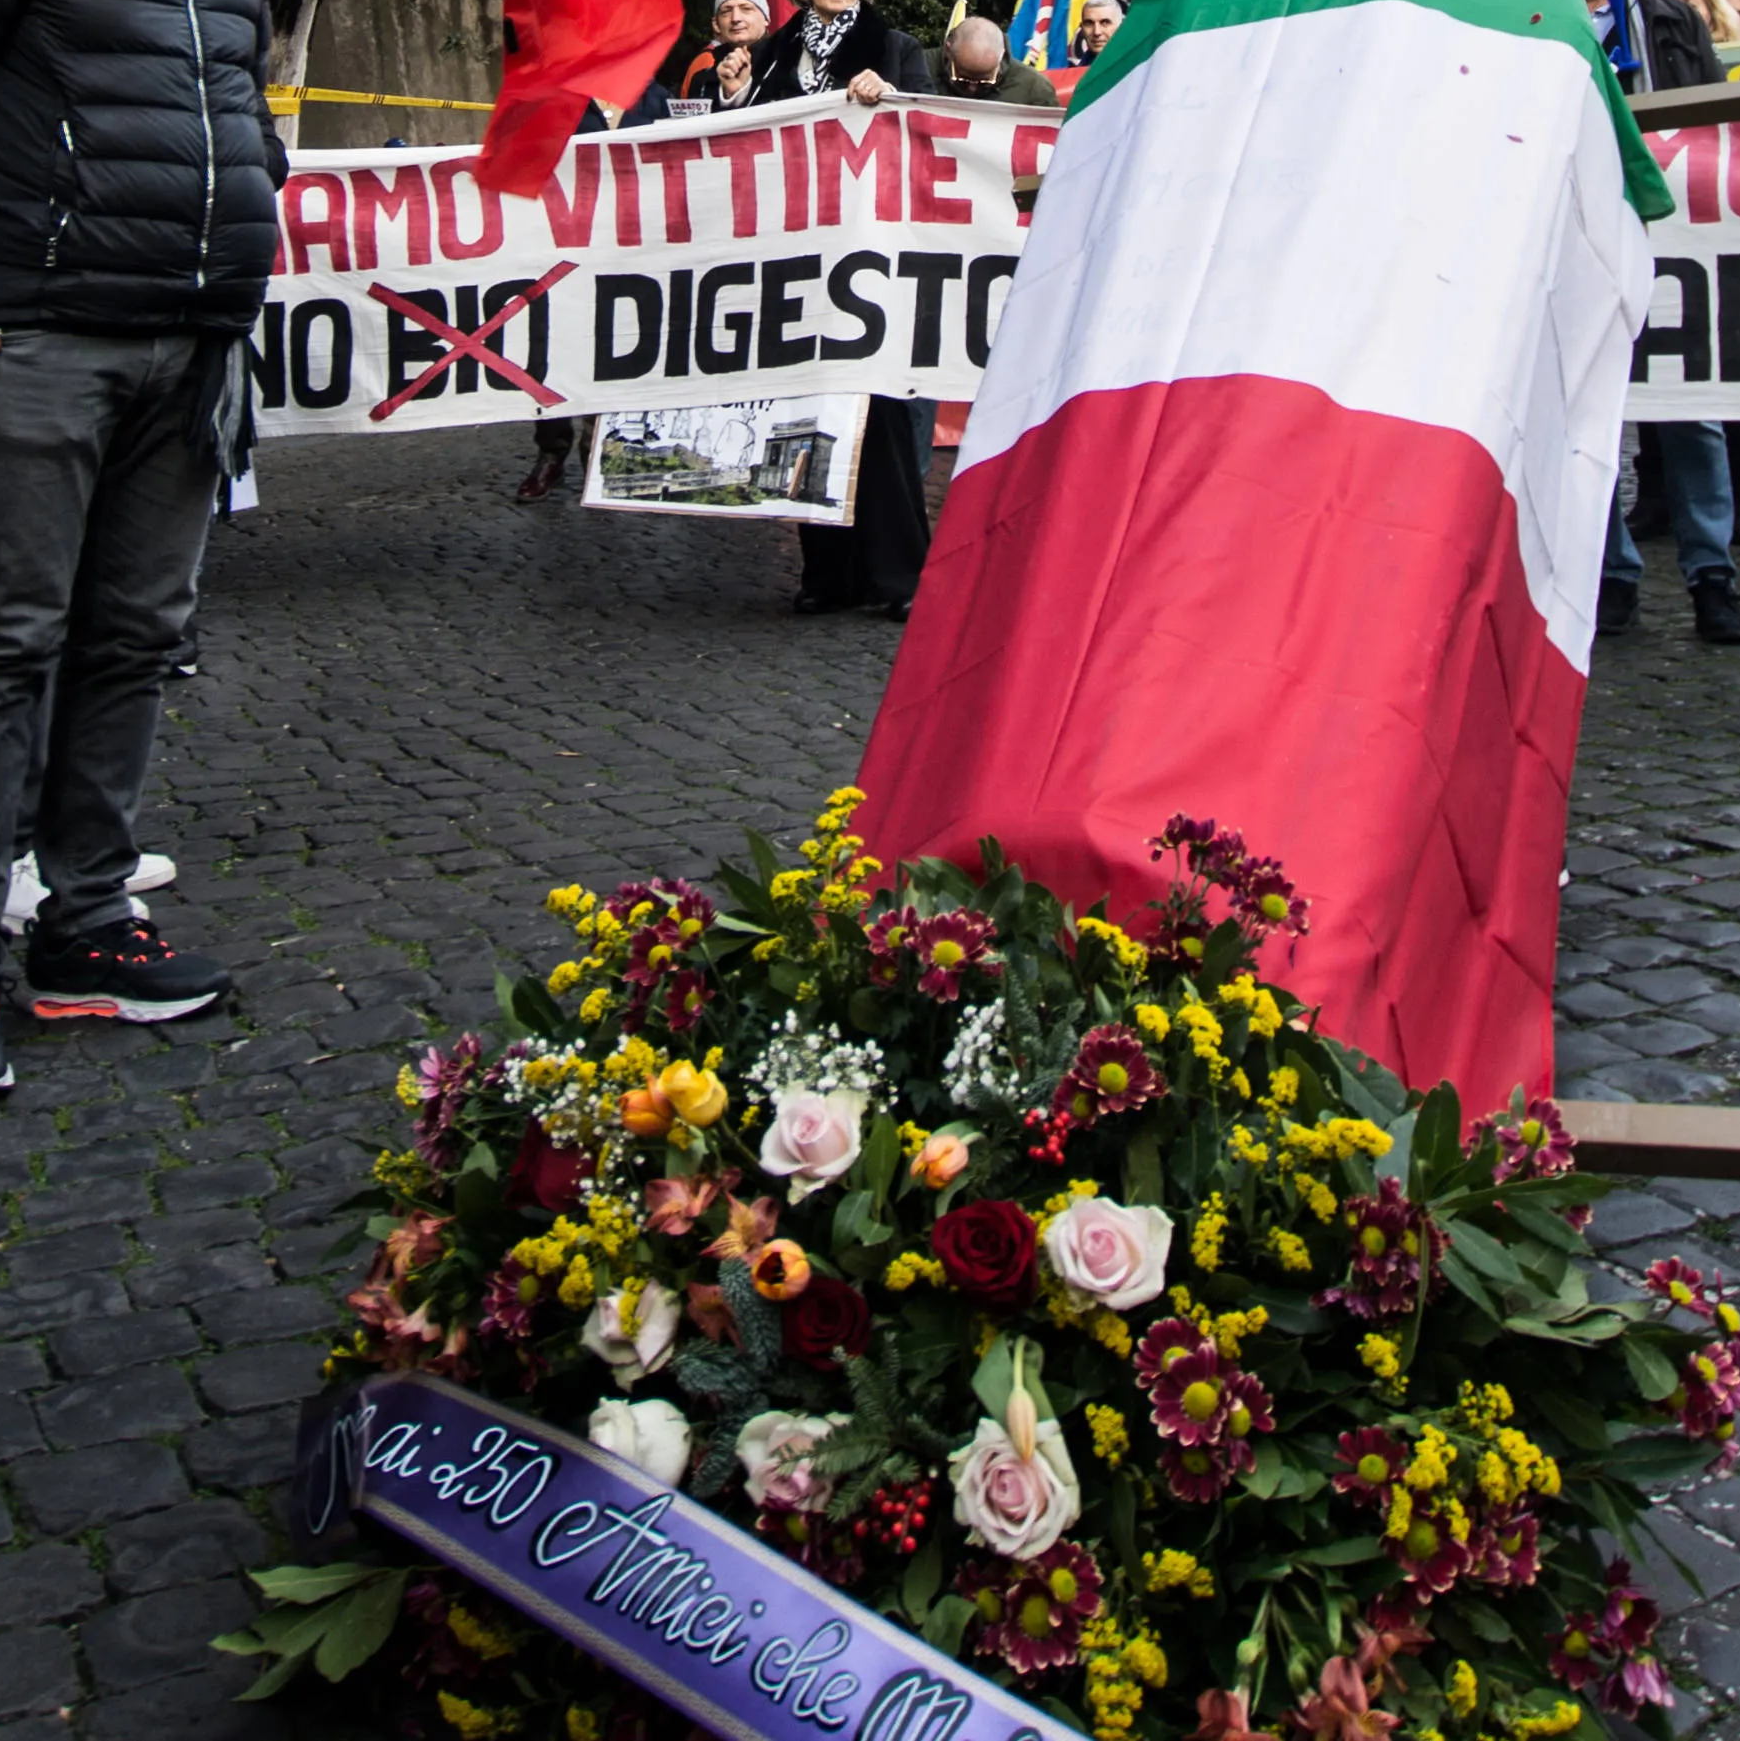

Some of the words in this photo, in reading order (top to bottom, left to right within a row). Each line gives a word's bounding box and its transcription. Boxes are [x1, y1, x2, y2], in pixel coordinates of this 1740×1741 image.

[540, 110, 972, 248] VITTIME
[387, 278, 549, 400] BIO
[429, 1426, 552, 1526] 250
[535, 1493, 766, 1665] Amici
[755, 1620, 859, 1726] che
